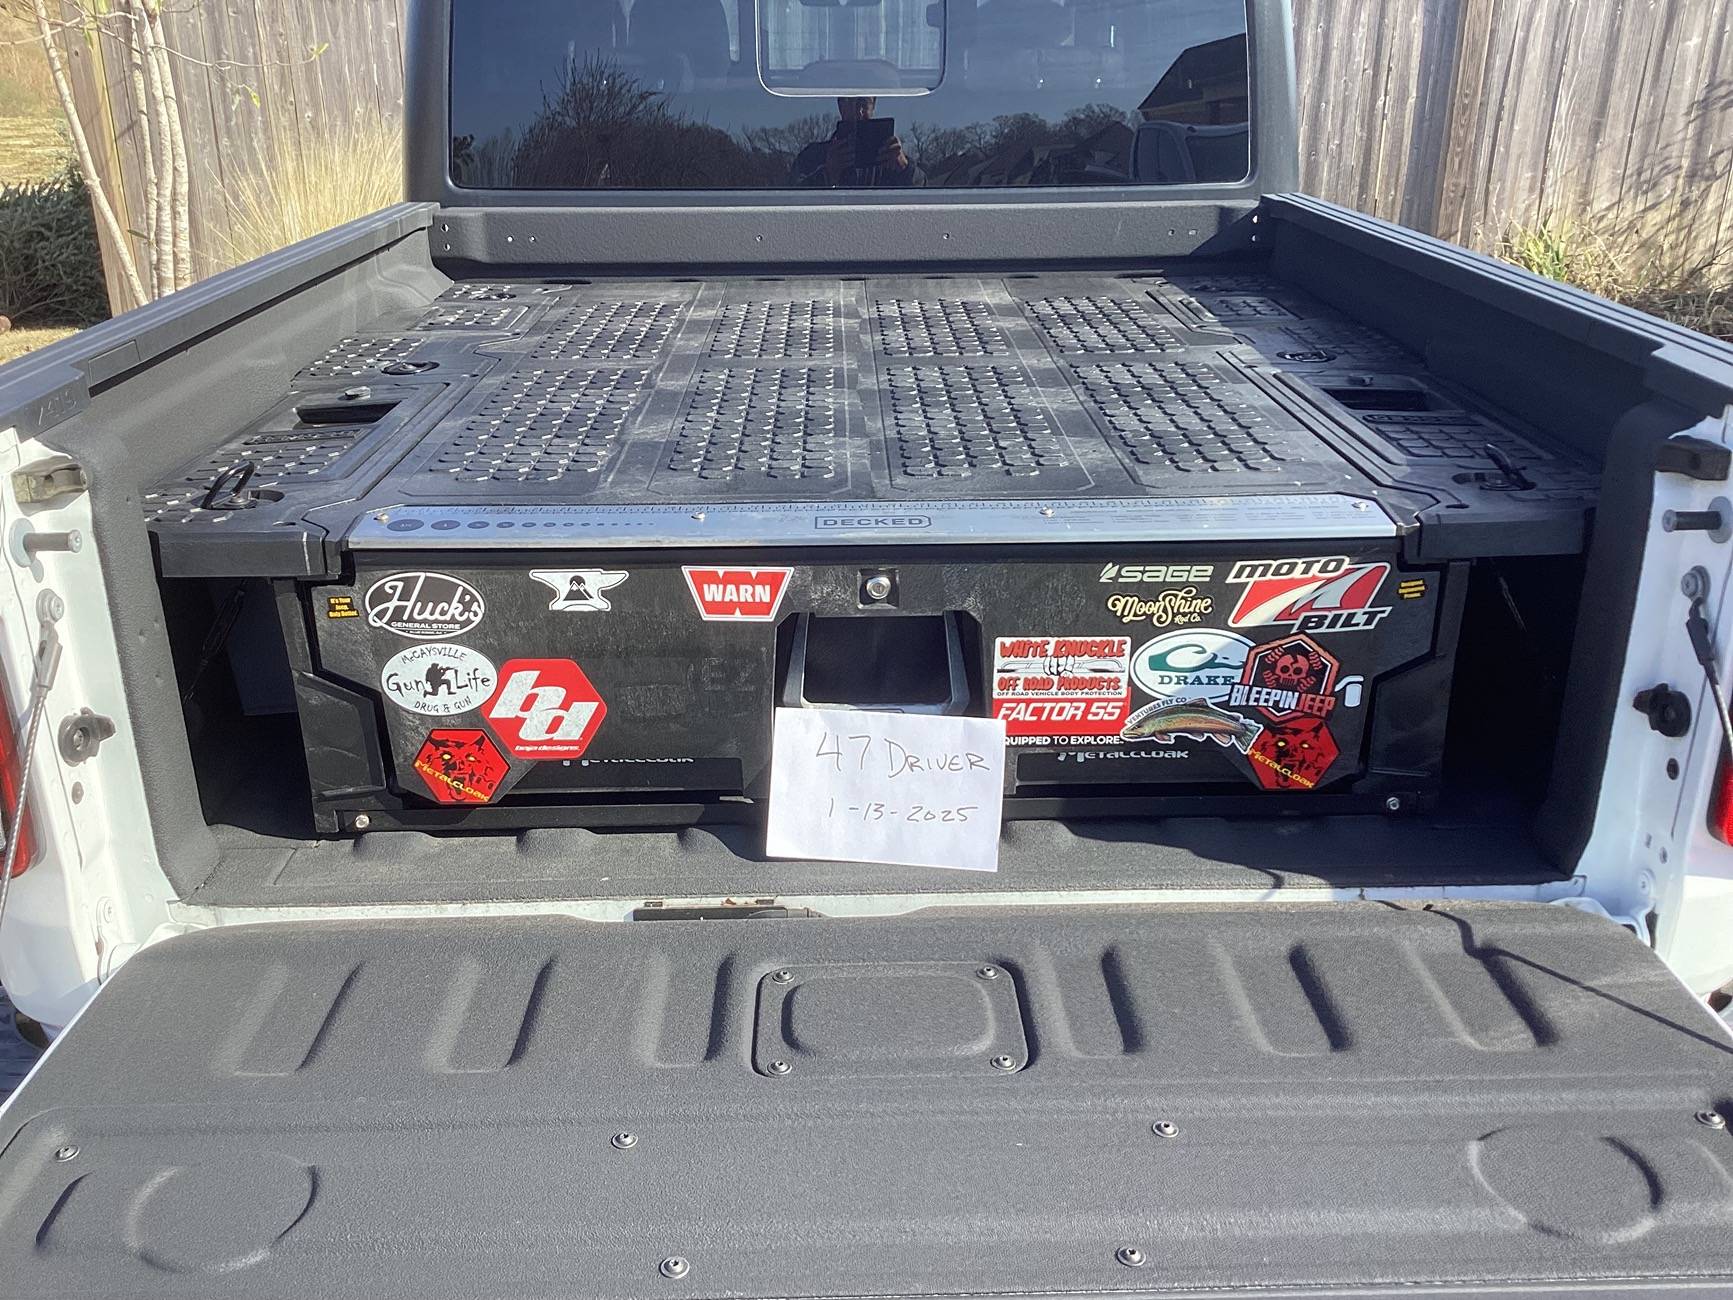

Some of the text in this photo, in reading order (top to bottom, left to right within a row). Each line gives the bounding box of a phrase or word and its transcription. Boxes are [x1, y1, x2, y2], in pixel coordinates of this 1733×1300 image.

[823, 518, 923, 527] DECKED
[1232, 558, 1346, 580] MOTO
[368, 573, 483, 627] Huck's
[703, 583, 771, 602] WARN
[390, 621, 431, 629] GENERAL
[1297, 610, 1387, 631] BILT
[1000, 639, 1127, 658] WHITE KNUCKLE
[386, 668, 490, 697] Gun Life
[997, 677, 1122, 691] OFF ROAD PRODUCTS
[1158, 675, 1235, 685] DRAKE
[415, 701, 440, 713] DRUG
[454, 696, 472, 710] GUN
[997, 702, 1123, 721] FACTOR 55
[1005, 736, 1050, 746] QUIPPED
[1053, 736, 1068, 745] TO
[815, 731, 871, 772] 47
